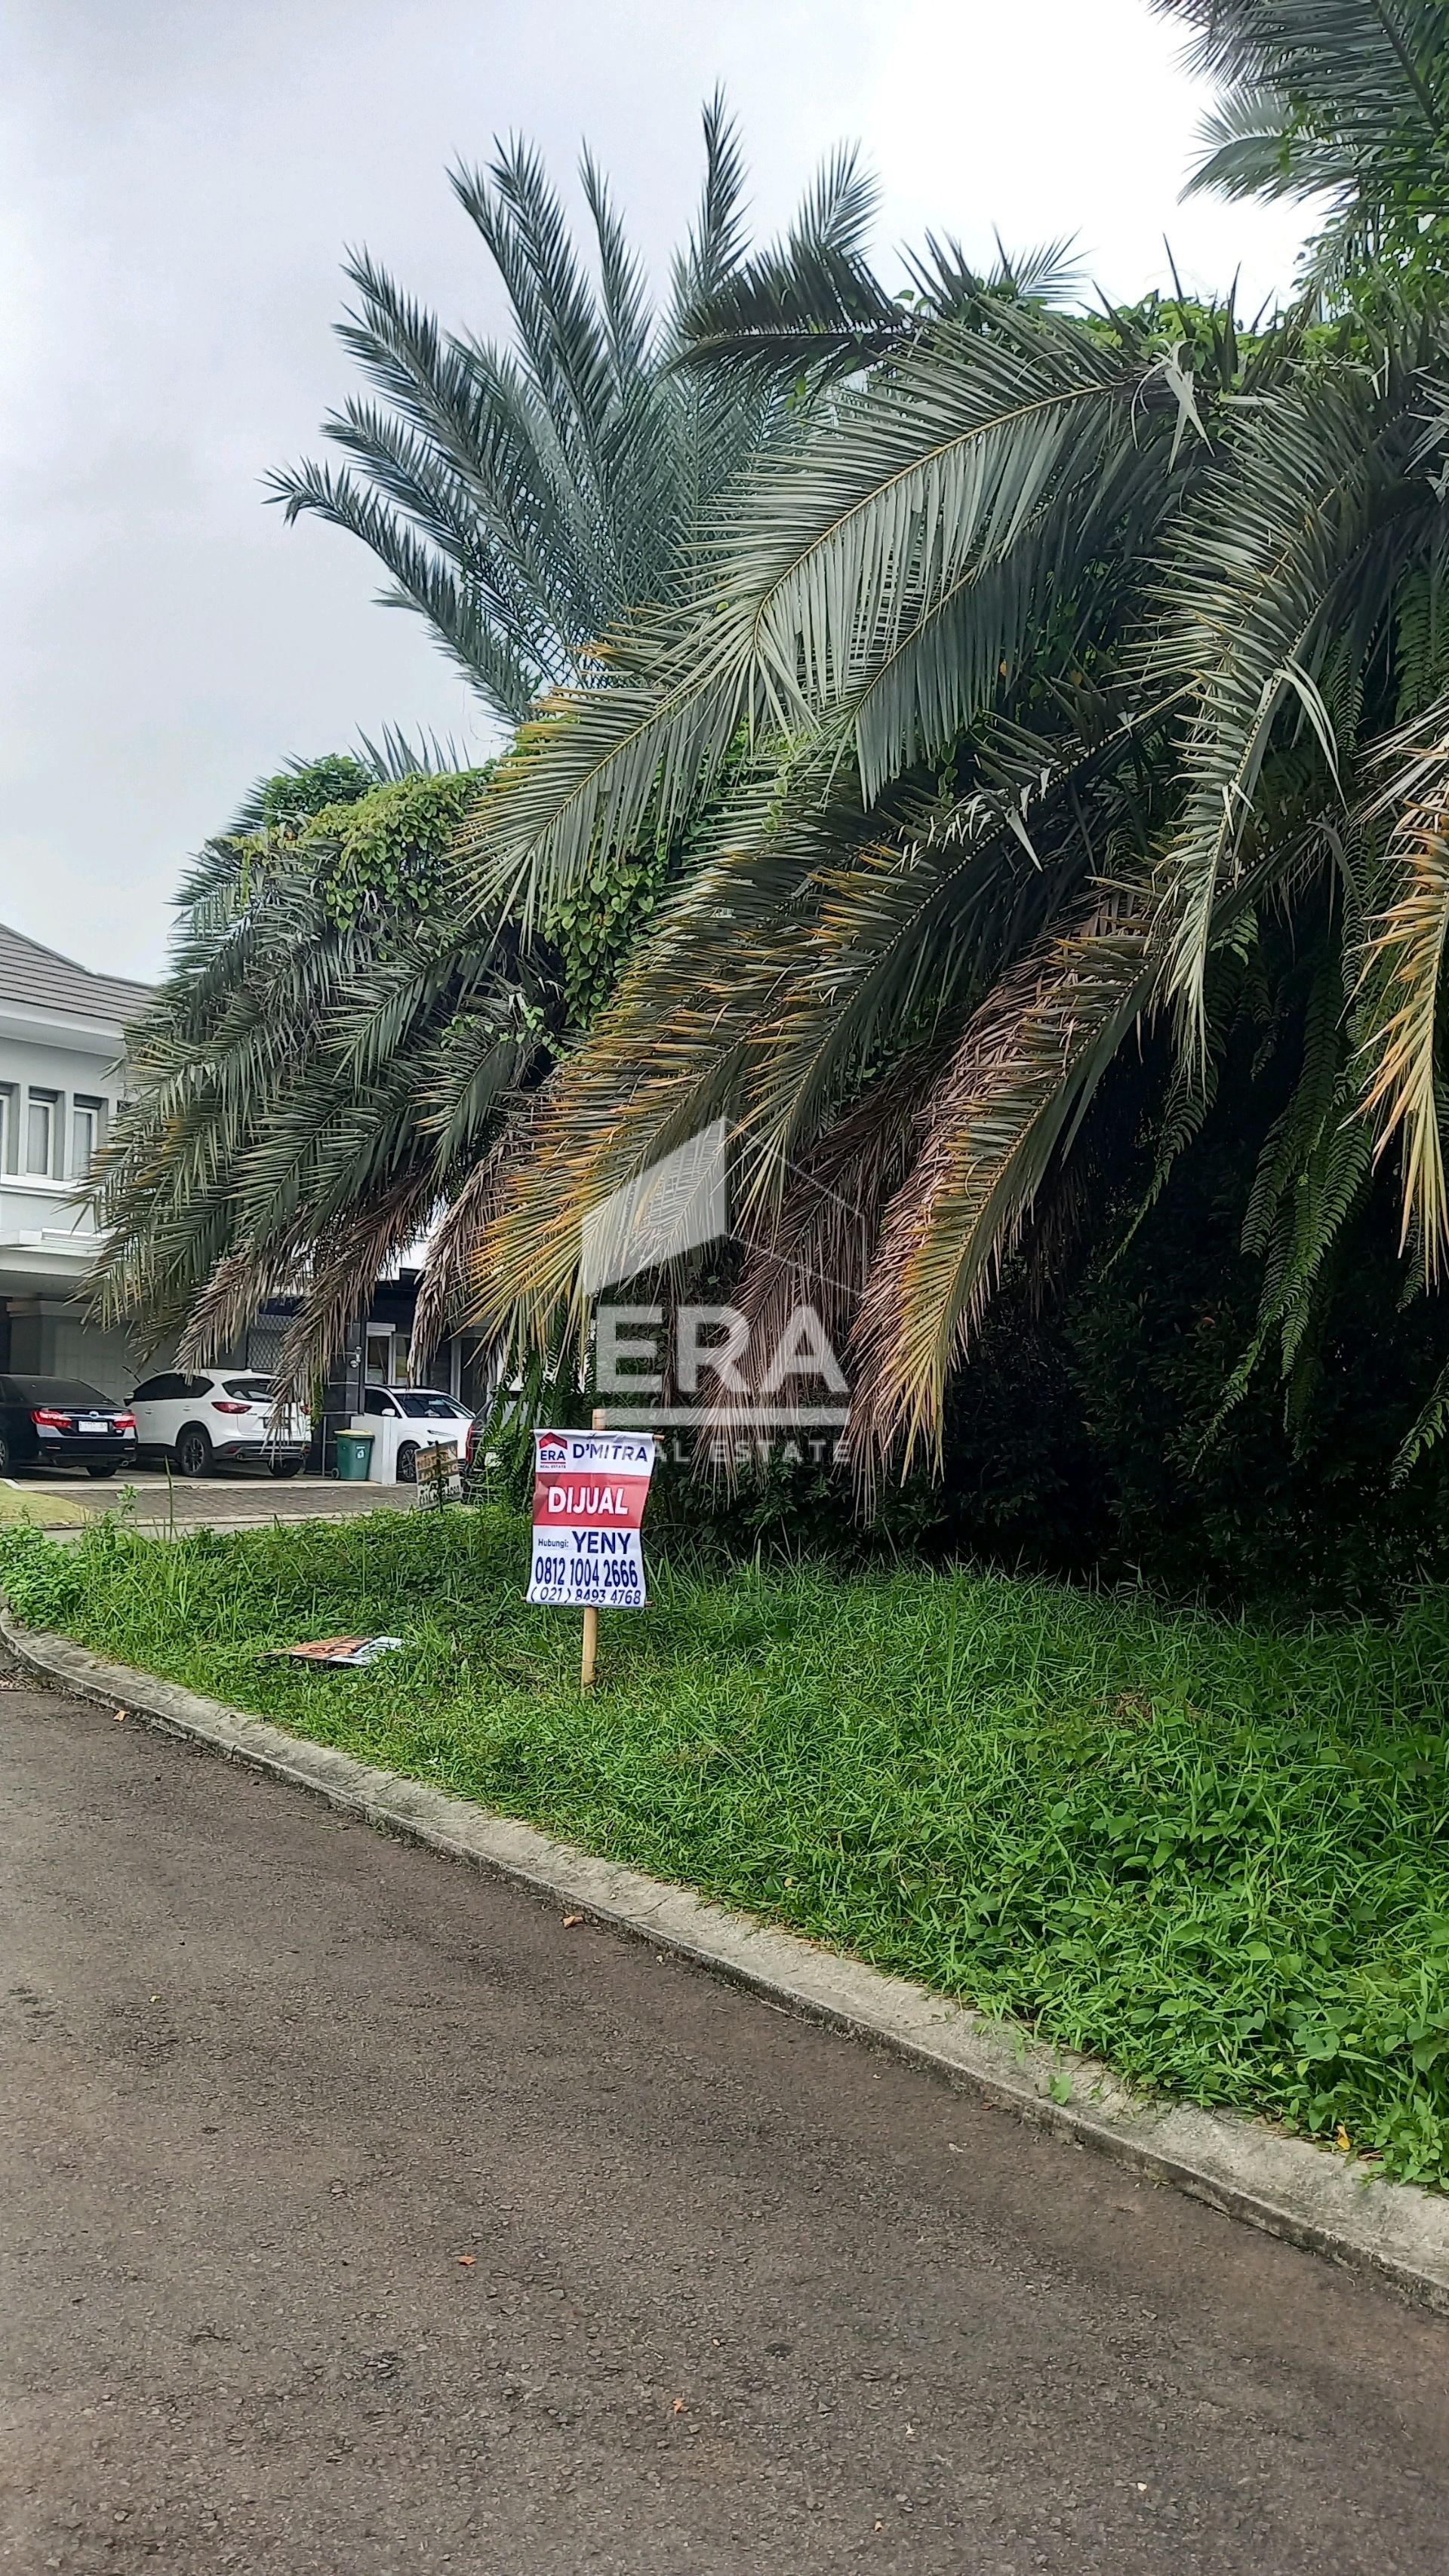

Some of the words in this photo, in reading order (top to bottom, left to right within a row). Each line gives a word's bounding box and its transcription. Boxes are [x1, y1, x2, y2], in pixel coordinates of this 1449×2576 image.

[540, 1450, 566, 1460] ERA
[549, 1487, 628, 1514] DIJUAL
[538, 1537, 569, 1549] Hubungi:
[572, 1531, 632, 1555] YENY
[535, 1557, 565, 1584] 0812
[570, 1558, 598, 1587] 1004
[604, 1559, 637, 1587] 2666
[575, 1588, 606, 1602] 8493
[610, 1589, 641, 1605] 4768
